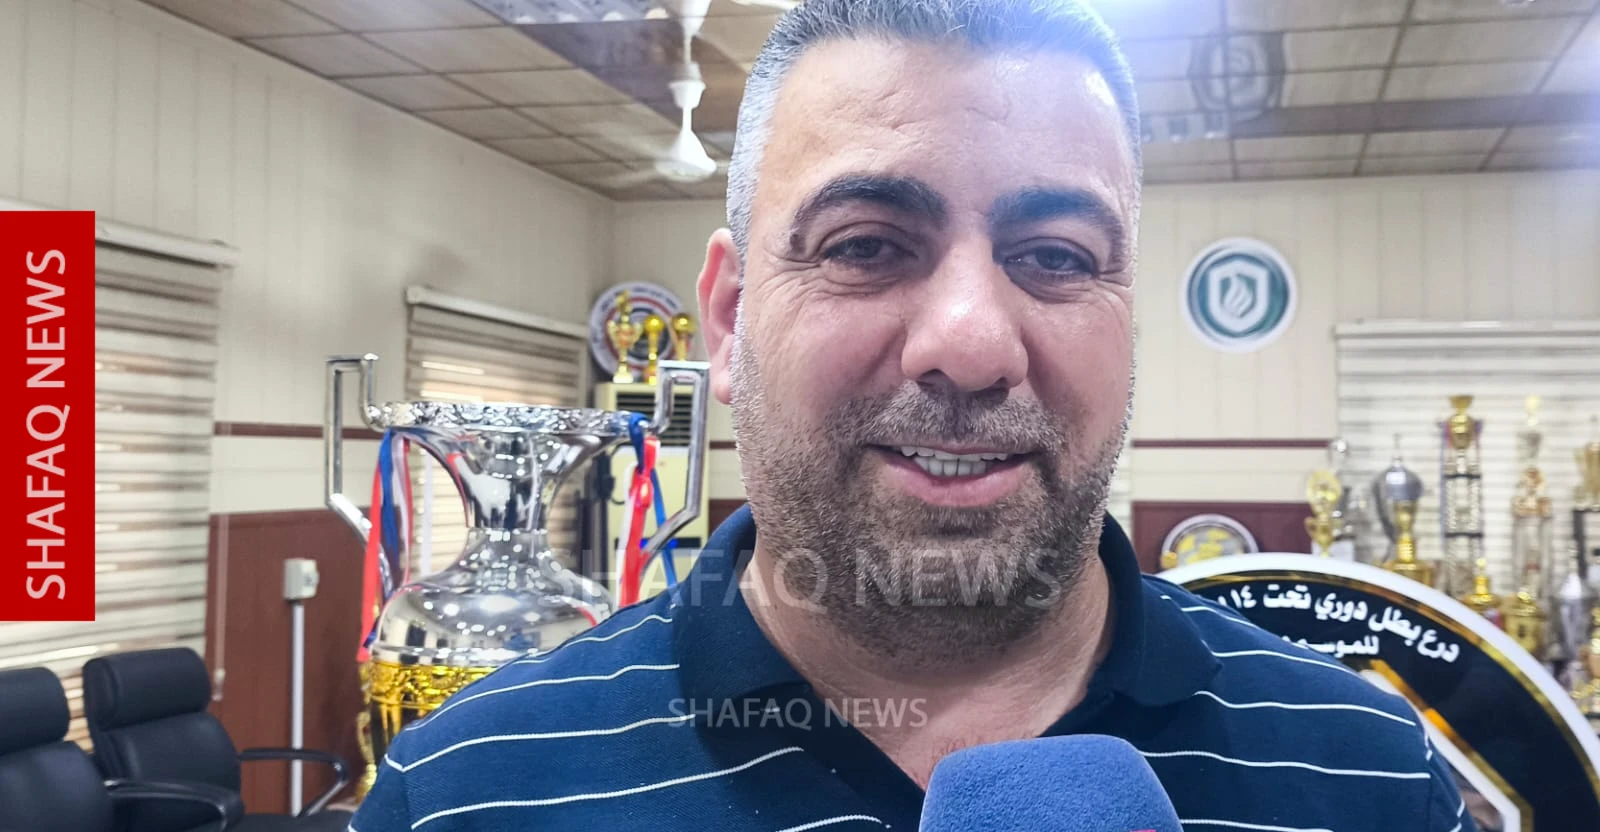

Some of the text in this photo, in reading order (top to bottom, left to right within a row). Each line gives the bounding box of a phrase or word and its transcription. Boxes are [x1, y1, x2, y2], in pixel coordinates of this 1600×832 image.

[1230, 584, 1460, 663] درع بطل دوري تحت ١٤
